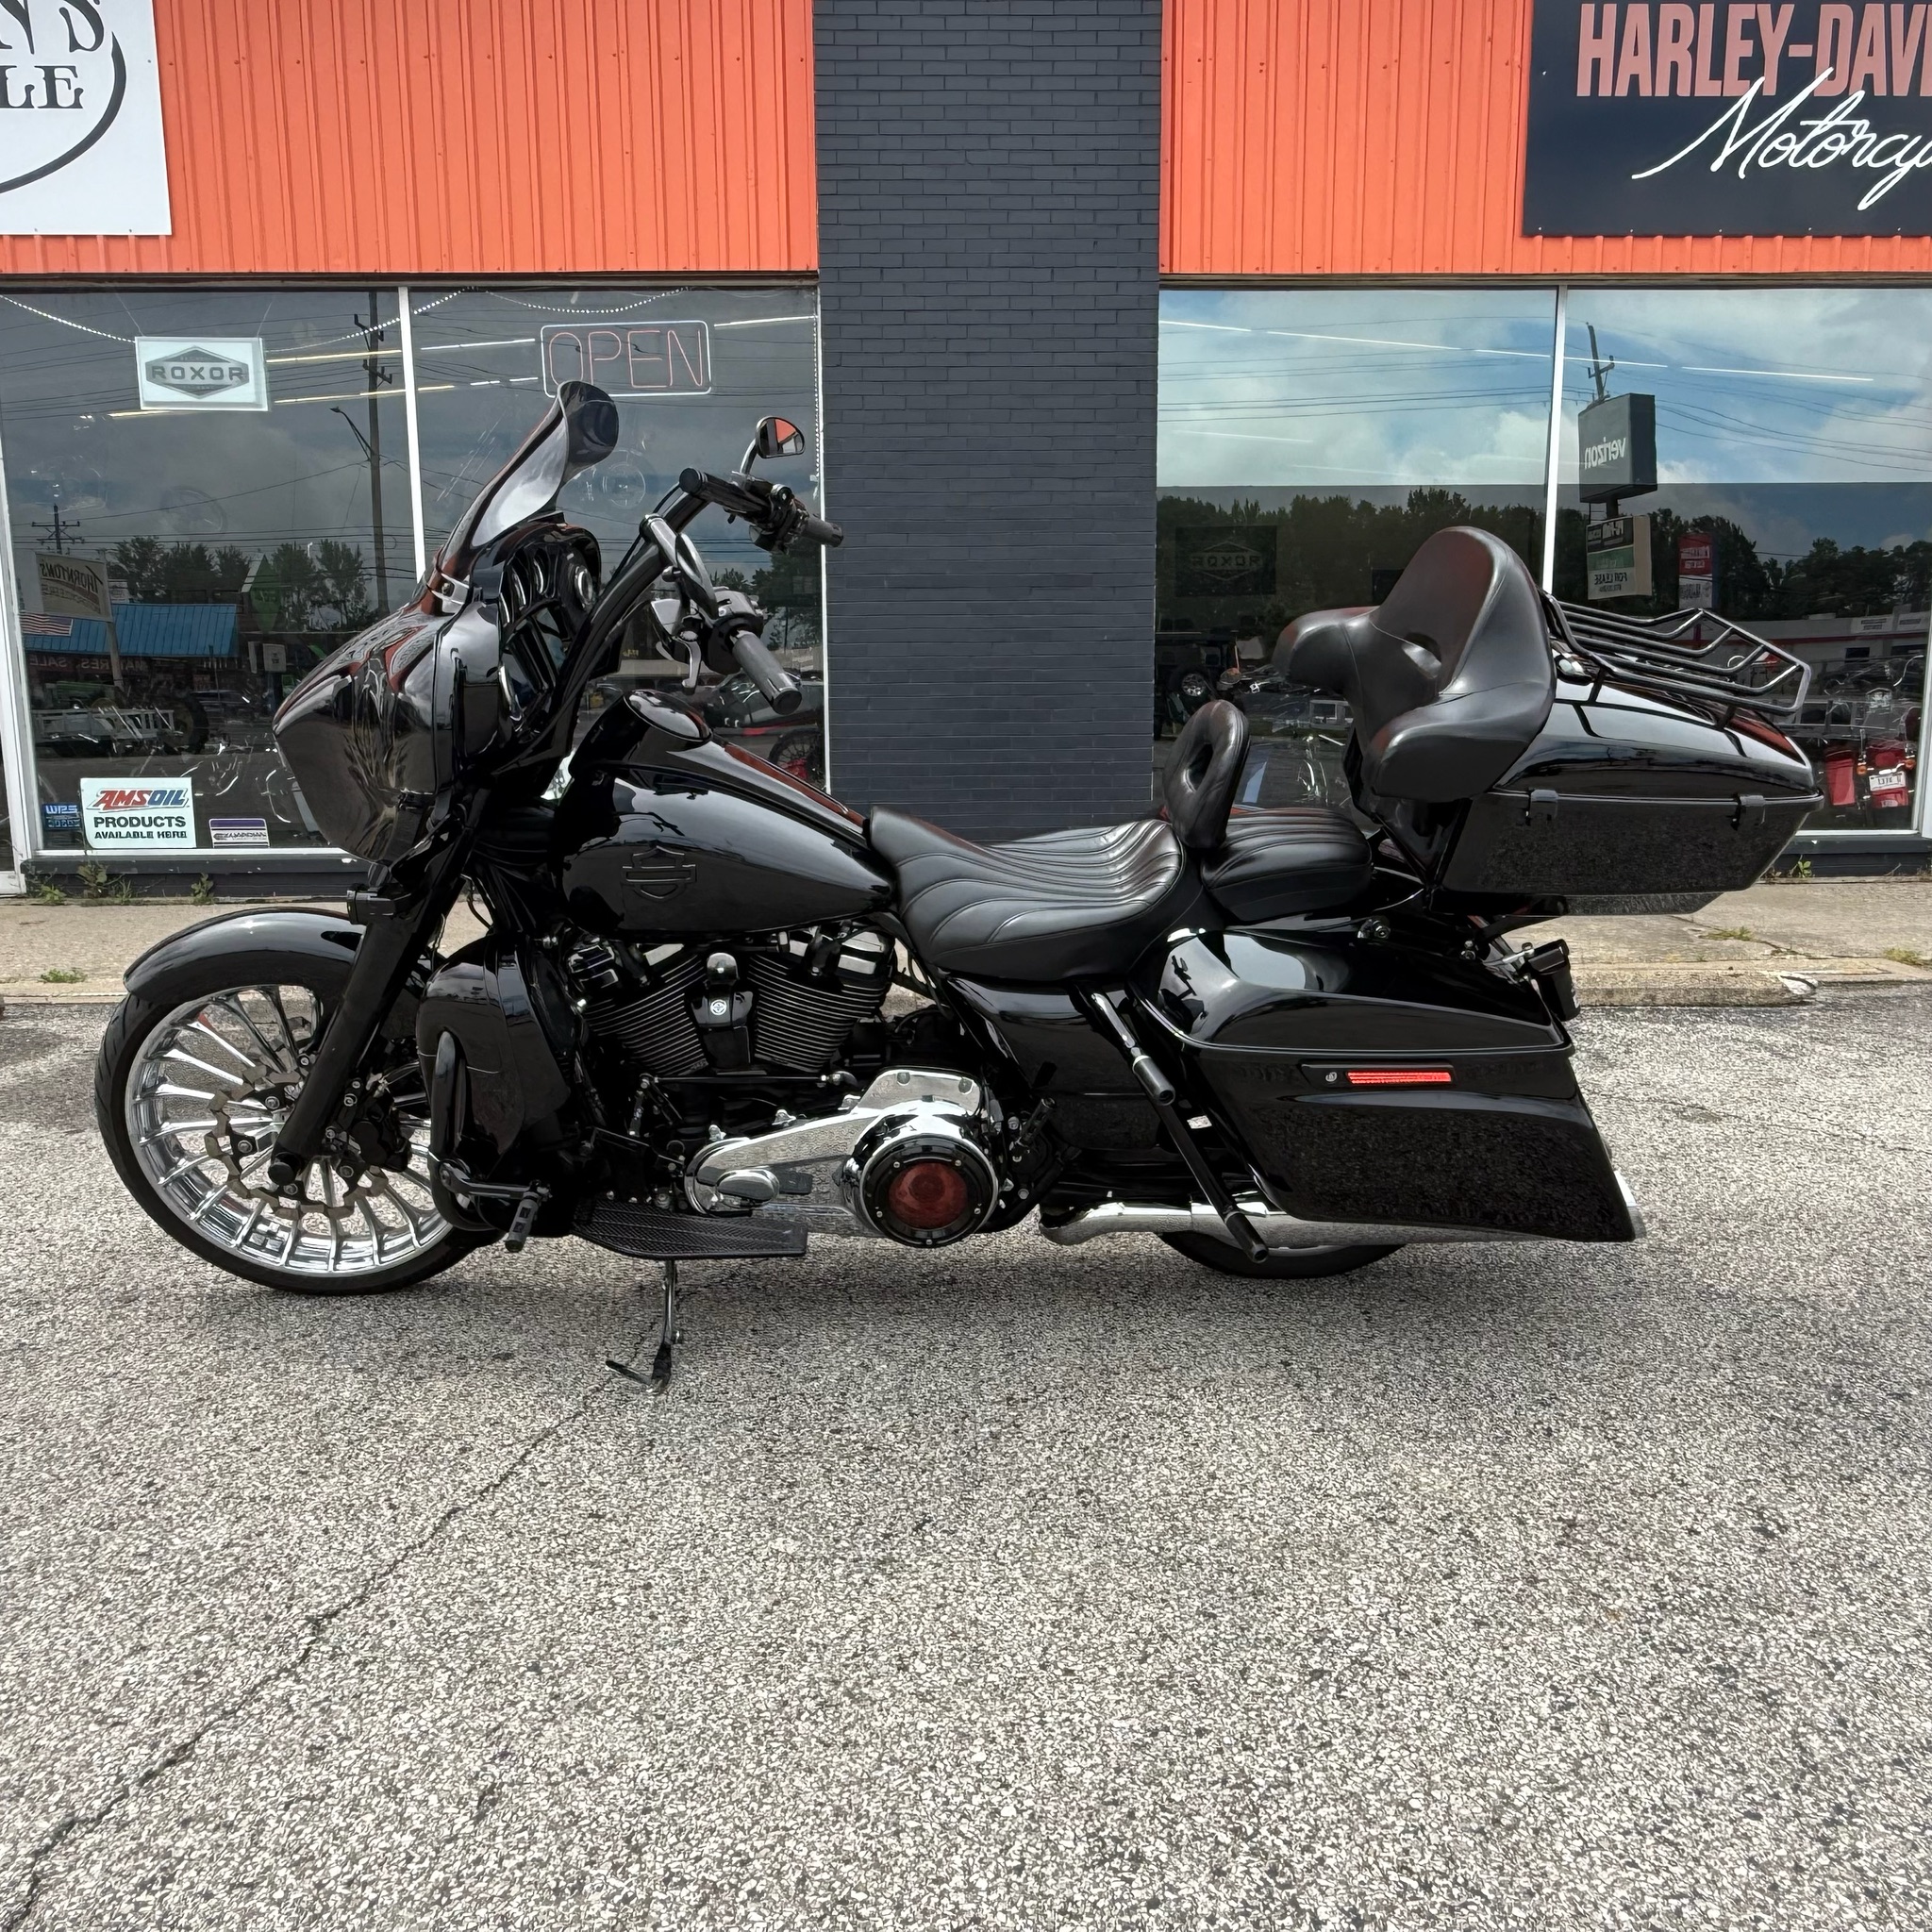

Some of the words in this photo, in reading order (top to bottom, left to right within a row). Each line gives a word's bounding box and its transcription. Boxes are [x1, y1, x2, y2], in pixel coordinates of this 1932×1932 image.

[1631, 67, 1932, 210] Motorcy
[549, 330, 703, 388] OPEN
[151, 365, 244, 381] ROXOR
[93, 789, 188, 810] AMSOIL
[93, 816, 187, 828] PRODUCTS
[94, 831, 154, 840] AVAILABLE
[157, 830, 187, 840] HERE
